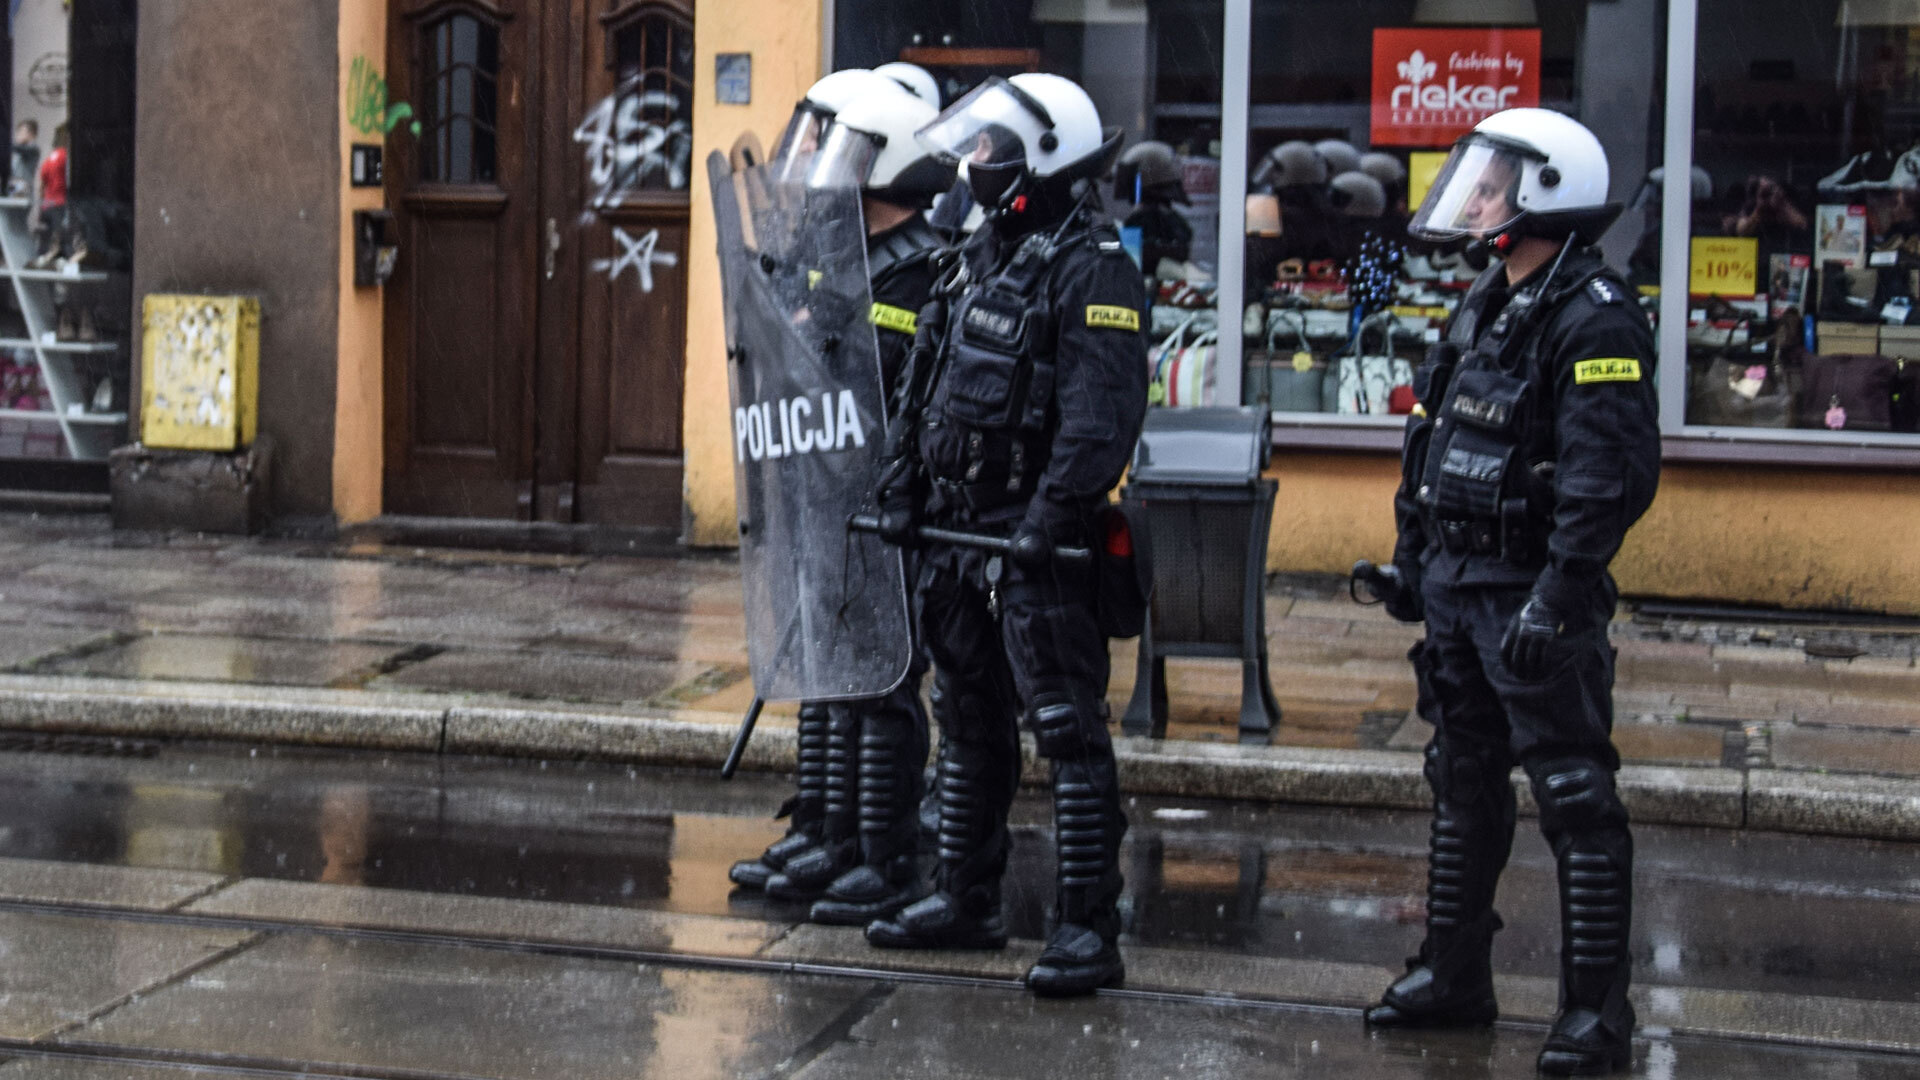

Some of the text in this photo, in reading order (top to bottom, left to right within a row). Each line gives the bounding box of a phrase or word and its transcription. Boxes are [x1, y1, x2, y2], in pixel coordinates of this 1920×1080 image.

[1448, 51, 1525, 77] fashion by
[1391, 75, 1519, 110] rieker
[1695, 261, 1753, 280] -10%
[967, 307, 1013, 334] POLICJA
[1091, 309, 1134, 323] POLICJA
[1581, 361, 1633, 376] POLICJA
[1453, 394, 1505, 424] POLICJA
[735, 389, 865, 464] POLICJA
